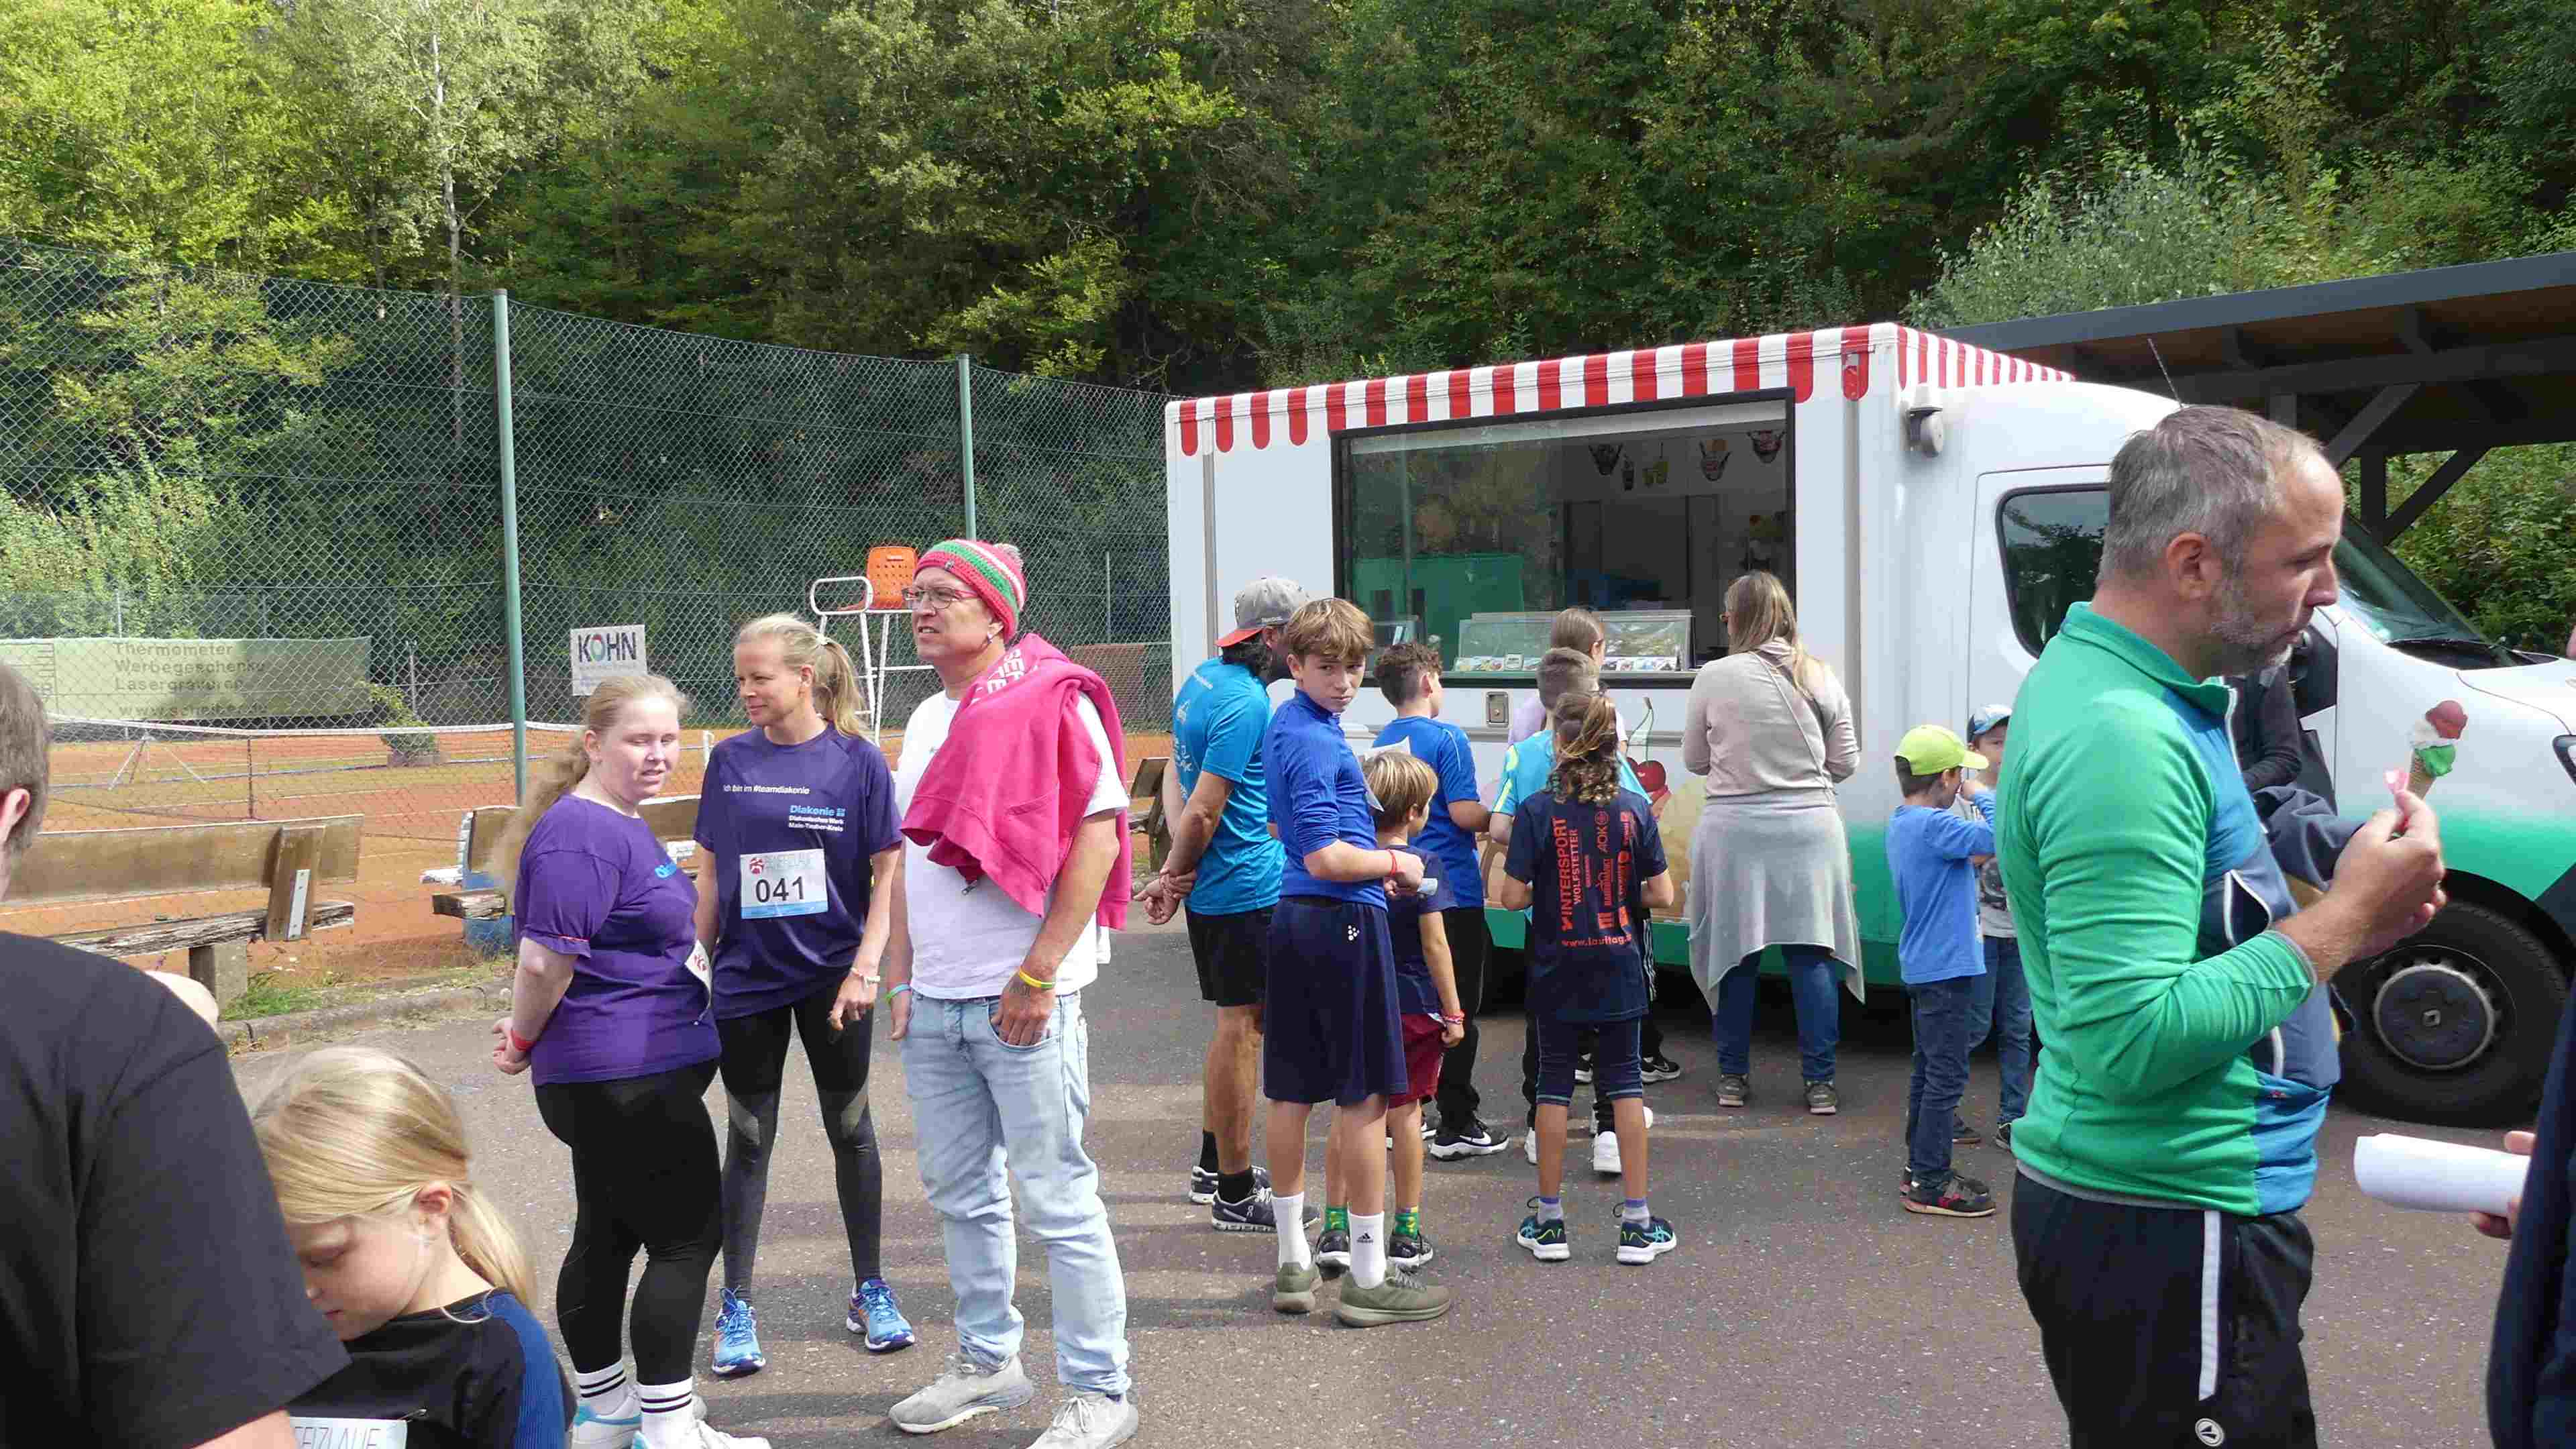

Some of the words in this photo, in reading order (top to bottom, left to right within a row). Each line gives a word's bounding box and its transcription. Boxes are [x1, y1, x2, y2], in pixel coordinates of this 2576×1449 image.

[114, 643, 233, 655] Thermometer
[578, 632, 637, 662] KOHN
[790, 805, 835, 816] Diakonie
[1596, 826, 1609, 853] AOK
[1552, 816, 1572, 915] INTERSPORT
[1568, 829, 1582, 904] WOLFSTETTER
[755, 876, 804, 903] 041
